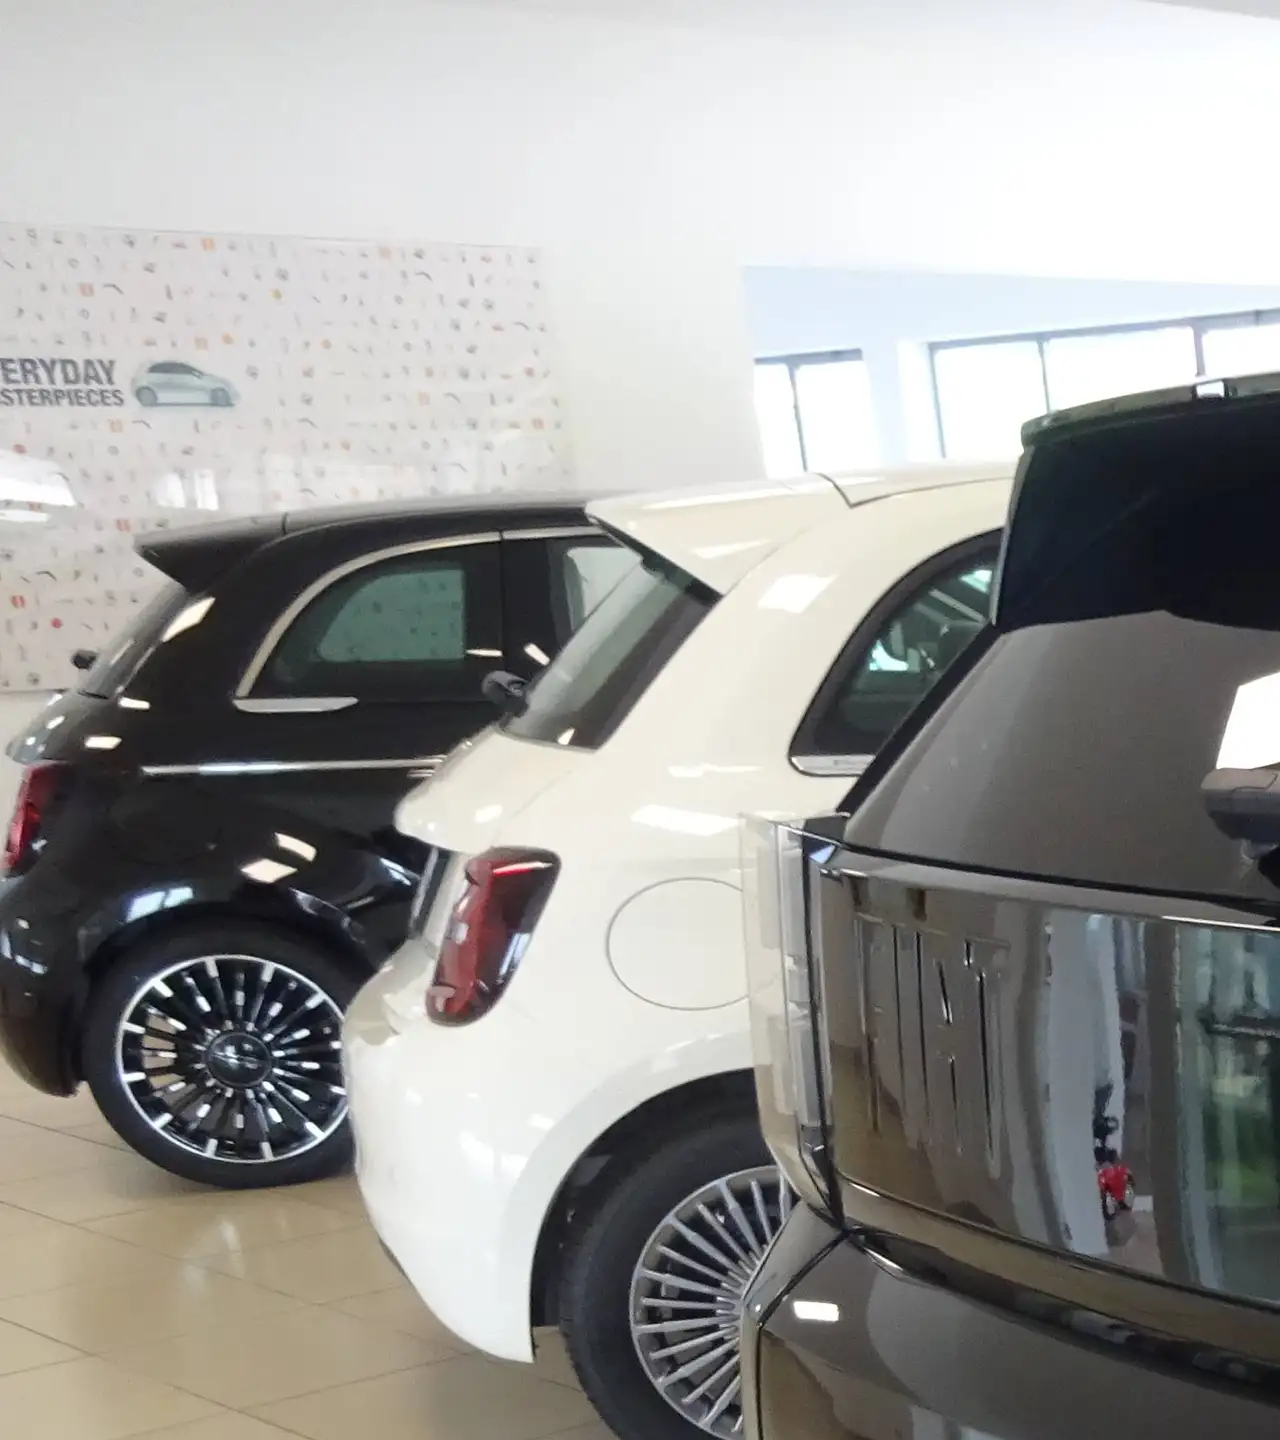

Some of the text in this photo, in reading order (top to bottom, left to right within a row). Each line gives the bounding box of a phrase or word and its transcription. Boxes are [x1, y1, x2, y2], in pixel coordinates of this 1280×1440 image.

[0, 357, 116, 385] ERYDAY
[0, 388, 125, 407] STERPIECES
[853, 910, 1012, 1180] FIAT
